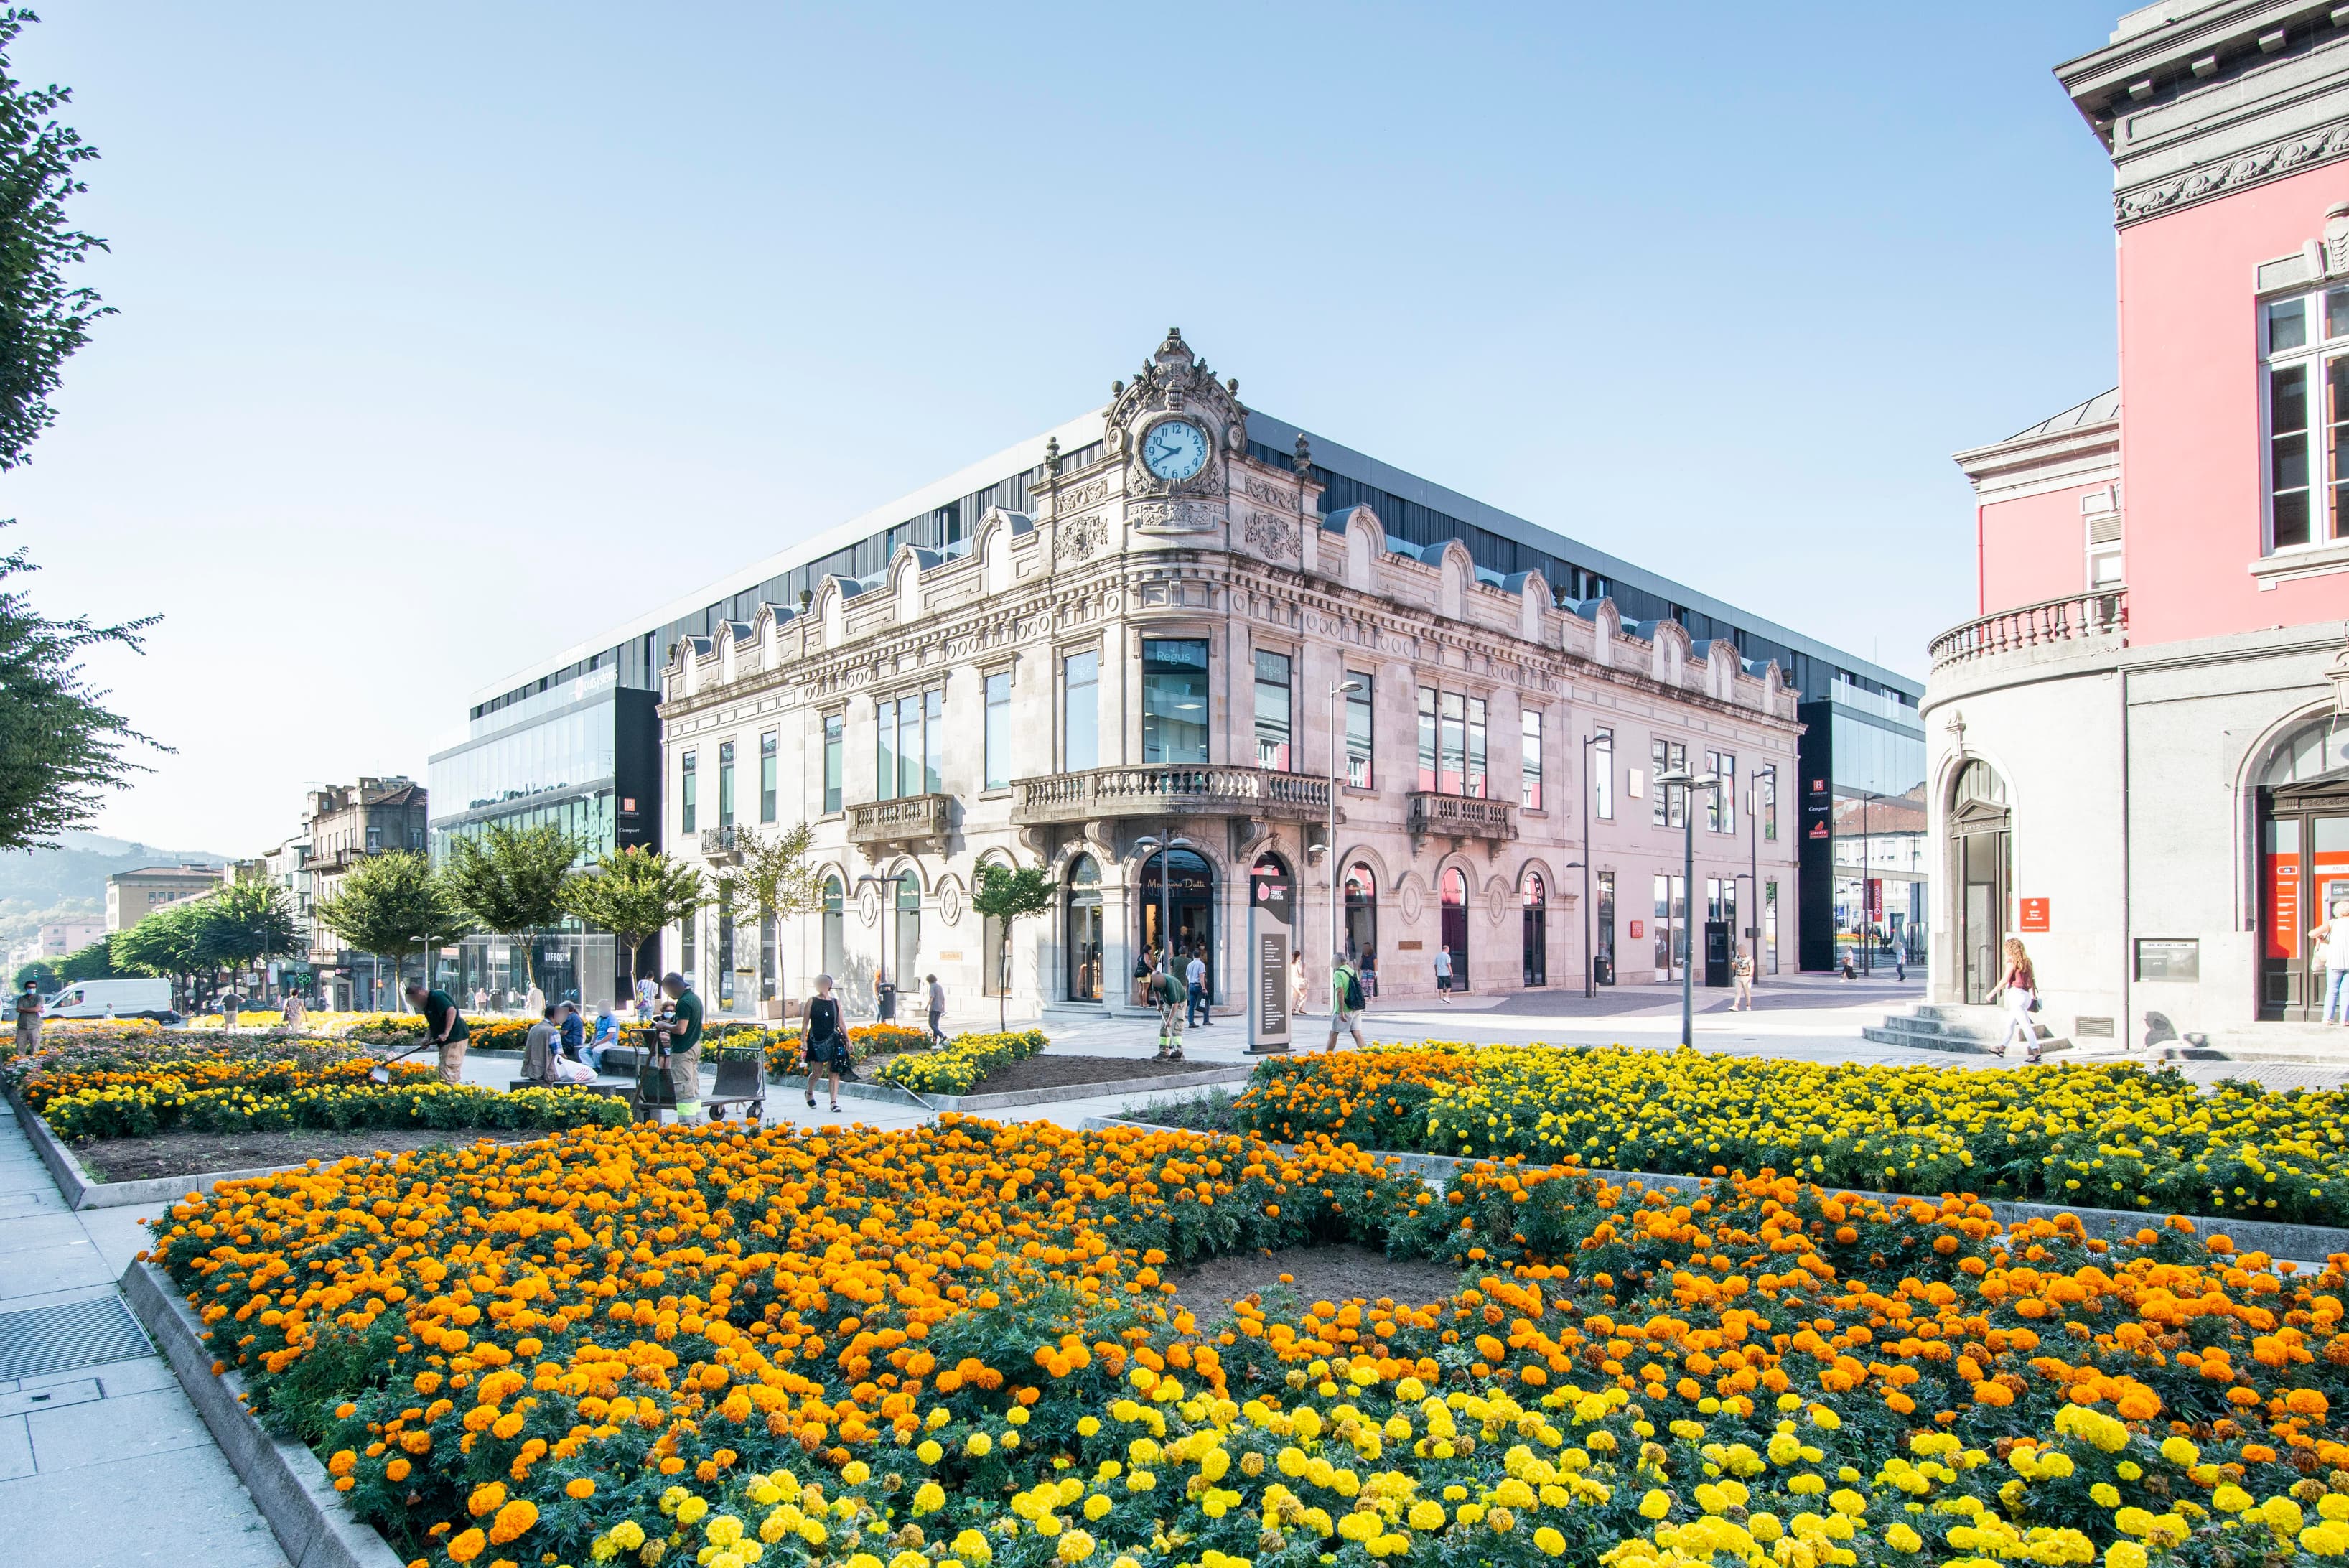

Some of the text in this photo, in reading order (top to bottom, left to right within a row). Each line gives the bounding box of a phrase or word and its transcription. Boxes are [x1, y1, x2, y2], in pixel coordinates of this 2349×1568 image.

[1162, 428, 1168, 437] 11
[1172, 424, 1181, 434] 12
[1153, 437, 1162, 446] 10
[1193, 435, 1199, 444] 2
[1149, 447, 1155, 456] 9
[1196, 447, 1202, 457] 3
[1152, 457, 1158, 467] 8
[1192, 457, 1198, 467] 4
[1162, 466, 1167, 475] 7
[1172, 469, 1178, 478] 6
[1184, 466, 1190, 475] 5
[1157, 651, 1190, 665] Regus
[1073, 666, 1091, 678] Regus
[1260, 661, 1281, 676] Regus
[1148, 878, 1206, 888] Maimo Dutti
